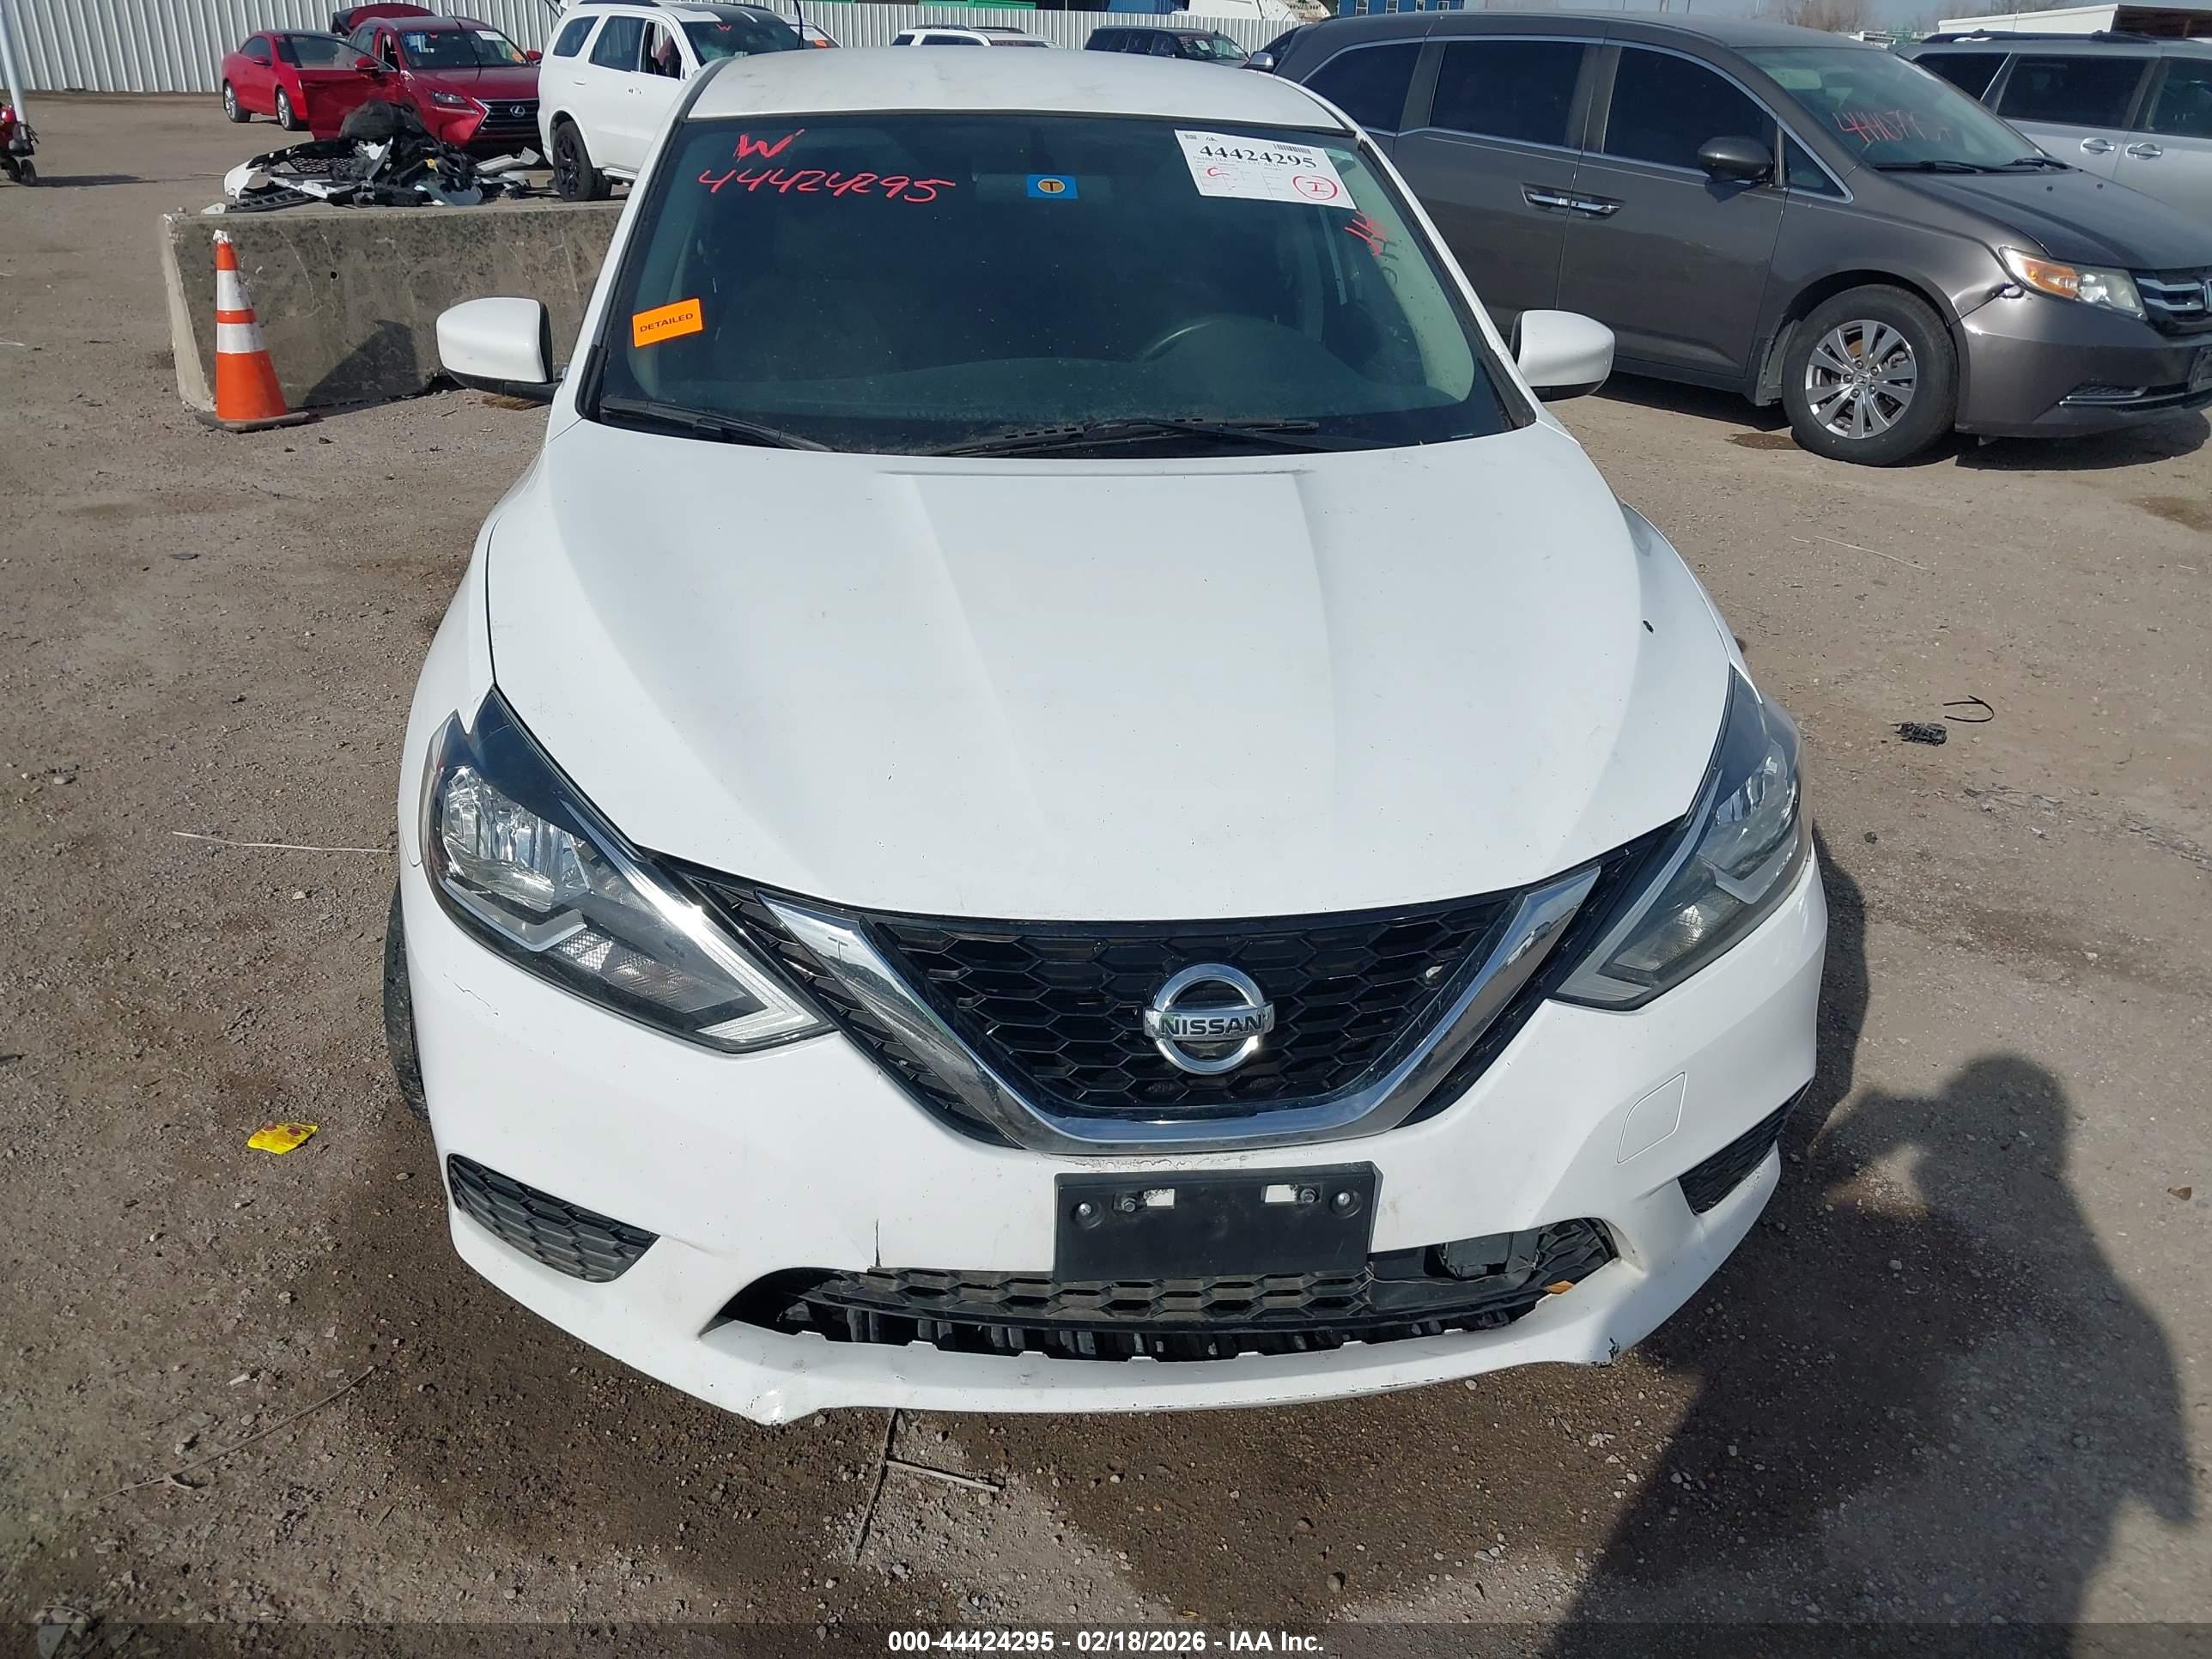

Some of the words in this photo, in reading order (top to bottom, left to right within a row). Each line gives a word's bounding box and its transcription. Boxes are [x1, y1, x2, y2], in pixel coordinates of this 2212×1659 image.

[733, 129, 805, 162] W
[1200, 145, 1316, 168] 44424295
[698, 168, 957, 202] 44424295
[1042, 180, 1060, 191] T
[640, 313, 694, 332] DETAILED
[1160, 1016, 1262, 1036] NISSAN
